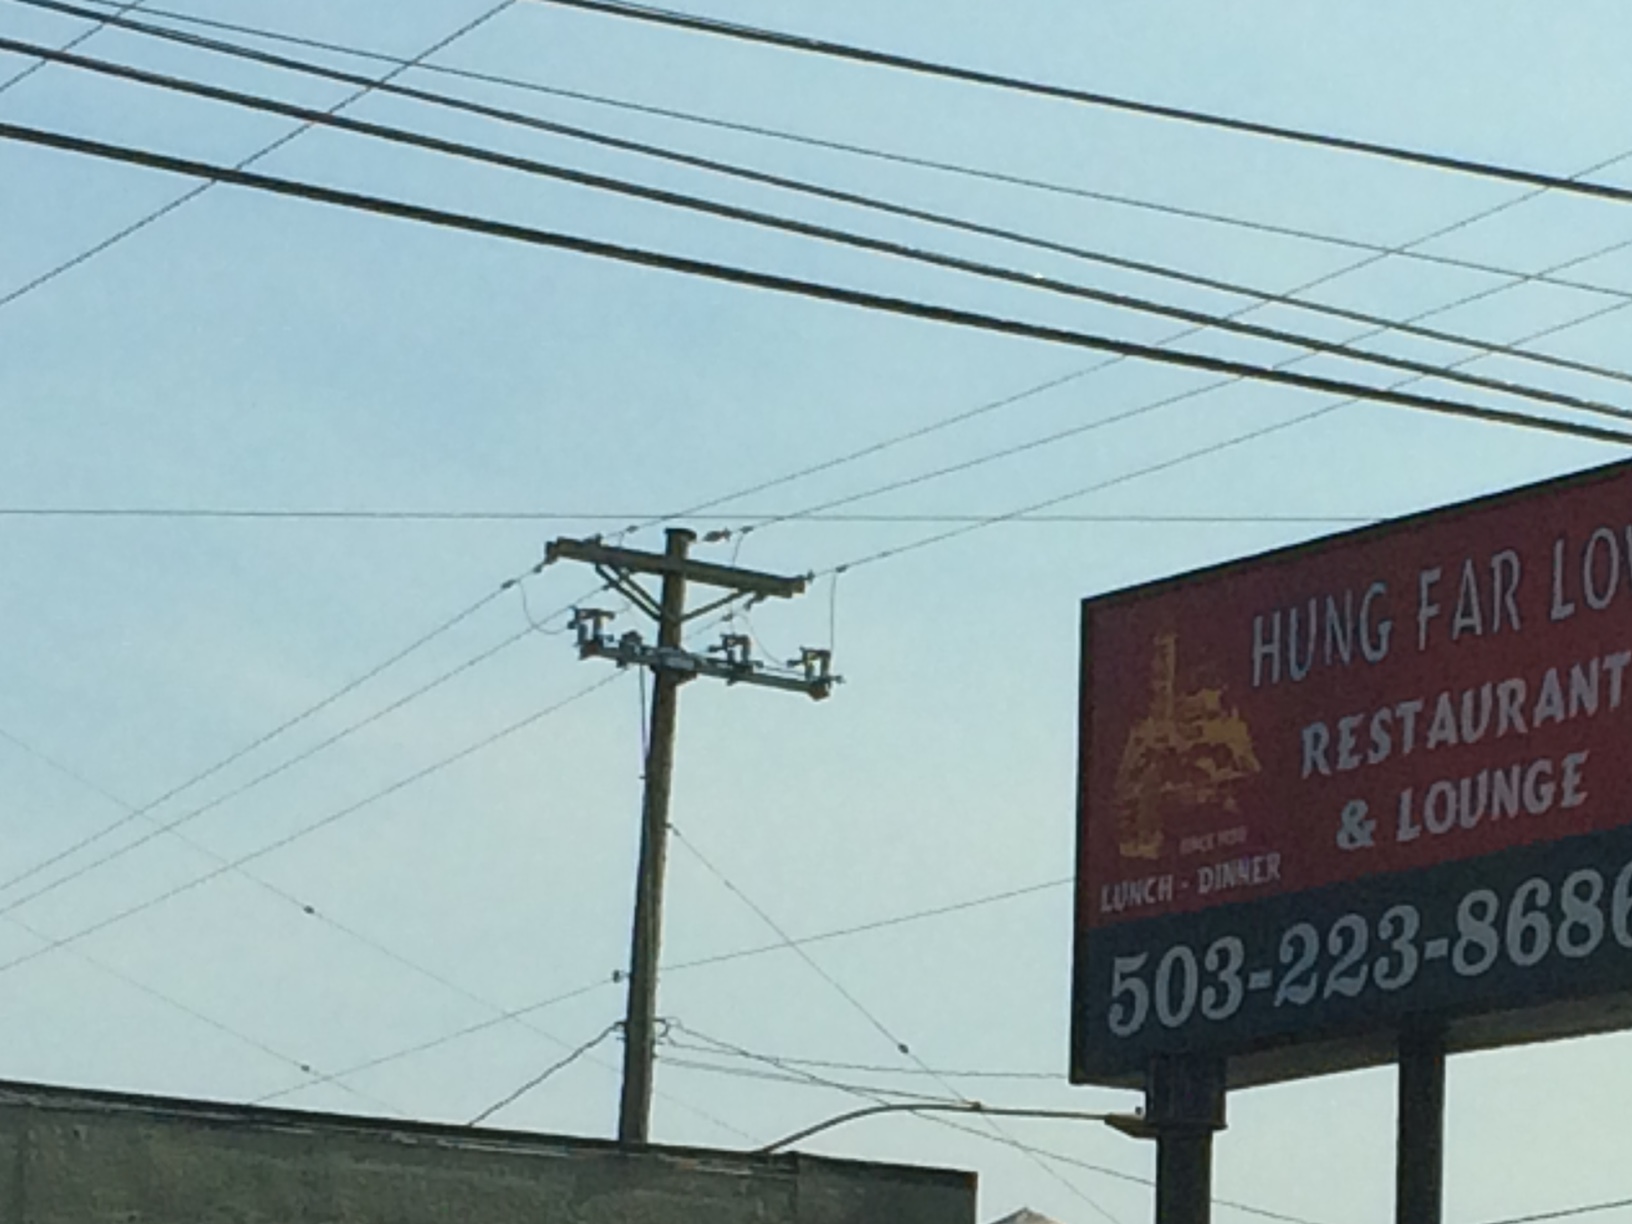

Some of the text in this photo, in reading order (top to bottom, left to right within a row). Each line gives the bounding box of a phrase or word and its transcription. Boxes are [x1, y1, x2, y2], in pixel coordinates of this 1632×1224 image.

[1253, 581, 1393, 687] HUNG
[1417, 549, 1521, 651] FAR
[1301, 650, 1632, 780] RESTAURANT
[1335, 750, 1590, 850] & LOUNGE
[1100, 873, 1174, 914] LUNCH
[1197, 852, 1282, 895] DINNER
